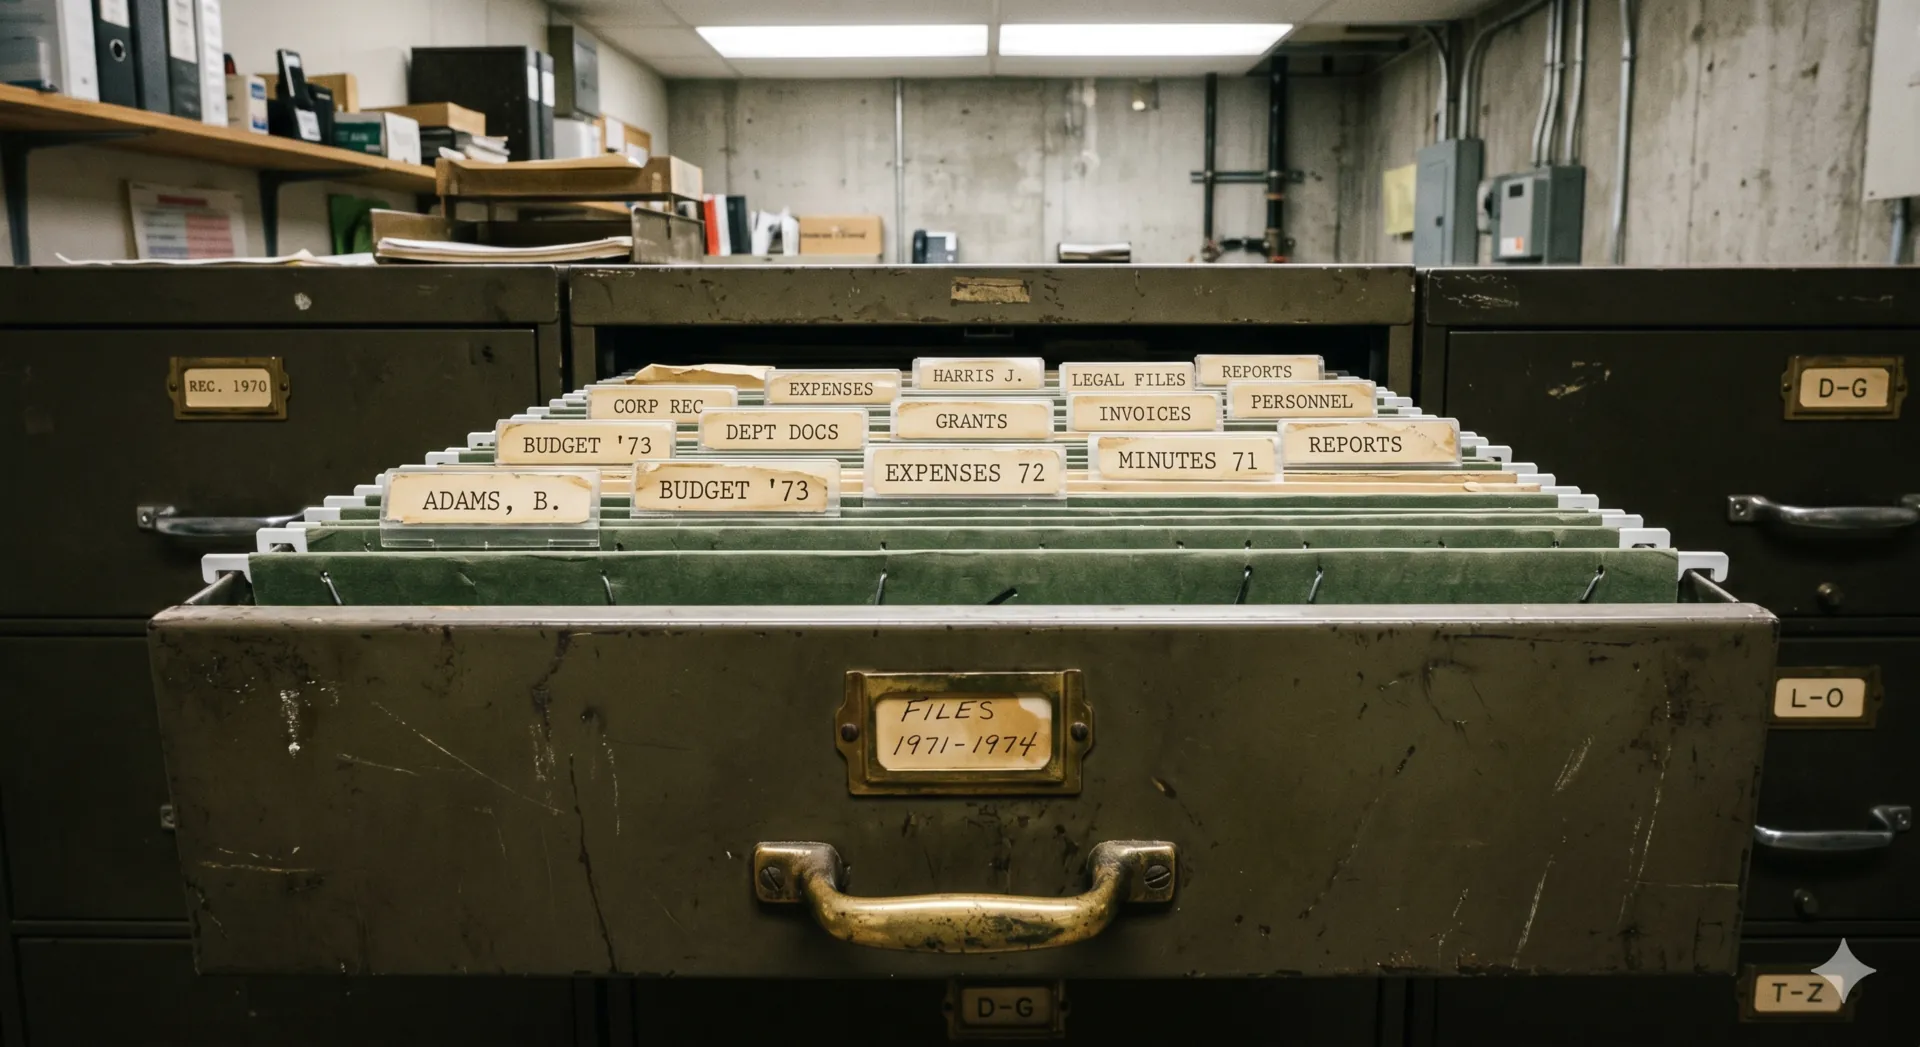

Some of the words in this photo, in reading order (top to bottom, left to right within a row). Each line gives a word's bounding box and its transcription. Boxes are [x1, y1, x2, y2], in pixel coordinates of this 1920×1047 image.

[933, 368, 995, 384] HARRIS
[1004, 368, 1024, 384] J.
[1072, 372, 1126, 388] LEGAL
[1134, 372, 1187, 388] FILES
[1221, 365, 1293, 379] REPORTS
[190, 381, 222, 393] REC.
[234, 380, 267, 392] 1970
[789, 382, 873, 396] EXPENSES
[1819, 378, 1867, 398] D-G
[613, 398, 659, 415] CORP
[670, 398, 704, 415] REC
[1251, 394, 1354, 411] PERSONNEL
[936, 414, 1008, 430] GRANTS
[1099, 405, 1192, 422] INVOICES
[726, 423, 777, 442] DEPT
[789, 423, 839, 442] DOCS
[523, 436, 601, 455] BUDGET
[617, 436, 653, 455] '73
[1309, 436, 1402, 453] REPORTS
[1118, 451, 1217, 470] MINUTES
[1233, 452, 1259, 471] 71
[885, 463, 1002, 483] EXPENSES
[1018, 463, 1046, 484] 72
[659, 480, 750, 500] BUDGET
[768, 478, 810, 502] '73
[422, 491, 514, 516] ADAMS,
[532, 492, 561, 511] B.
[902, 697, 994, 722] FILES
[893, 731, 1038, 757] 1971-1974
[1772, 983, 1825, 1003] T-Z
[977, 997, 1034, 1018] D-G
